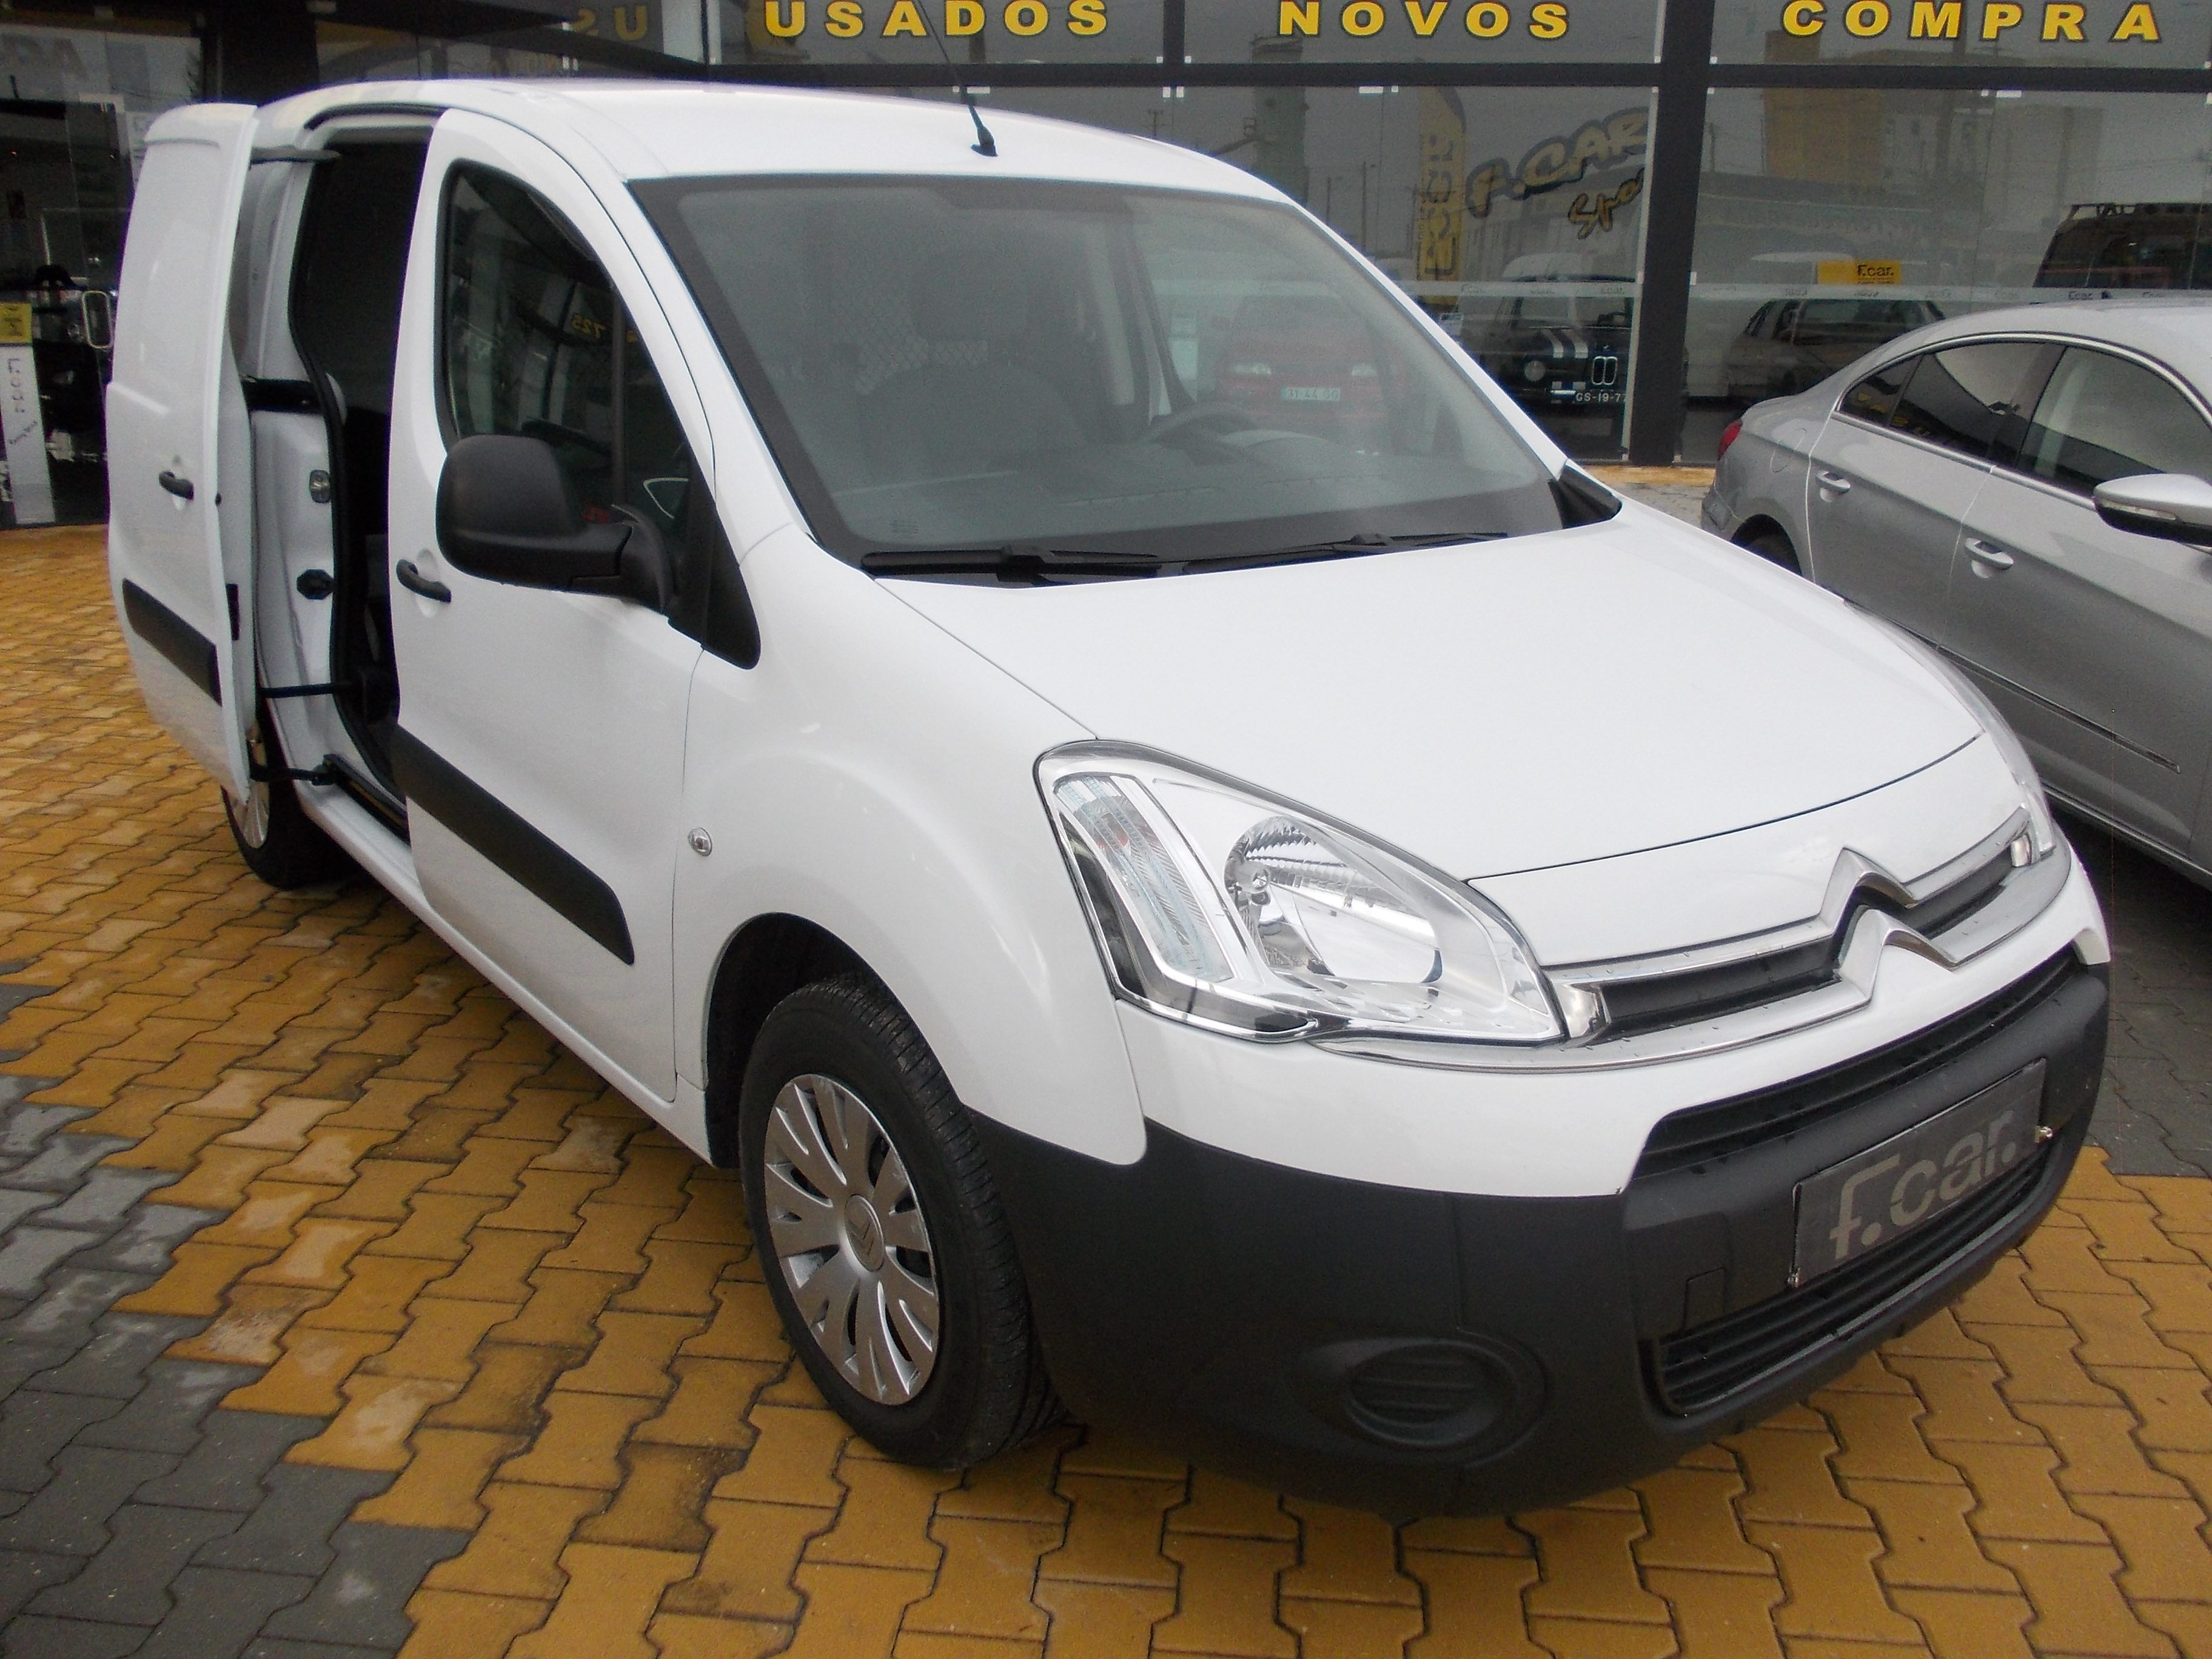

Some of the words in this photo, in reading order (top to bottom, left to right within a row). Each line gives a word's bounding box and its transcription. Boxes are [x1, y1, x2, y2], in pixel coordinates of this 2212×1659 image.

[763, 0, 1108, 38] USADOS
[1277, 0, 1571, 39] NOVOS
[1781, 0, 2162, 42] COMPRA
